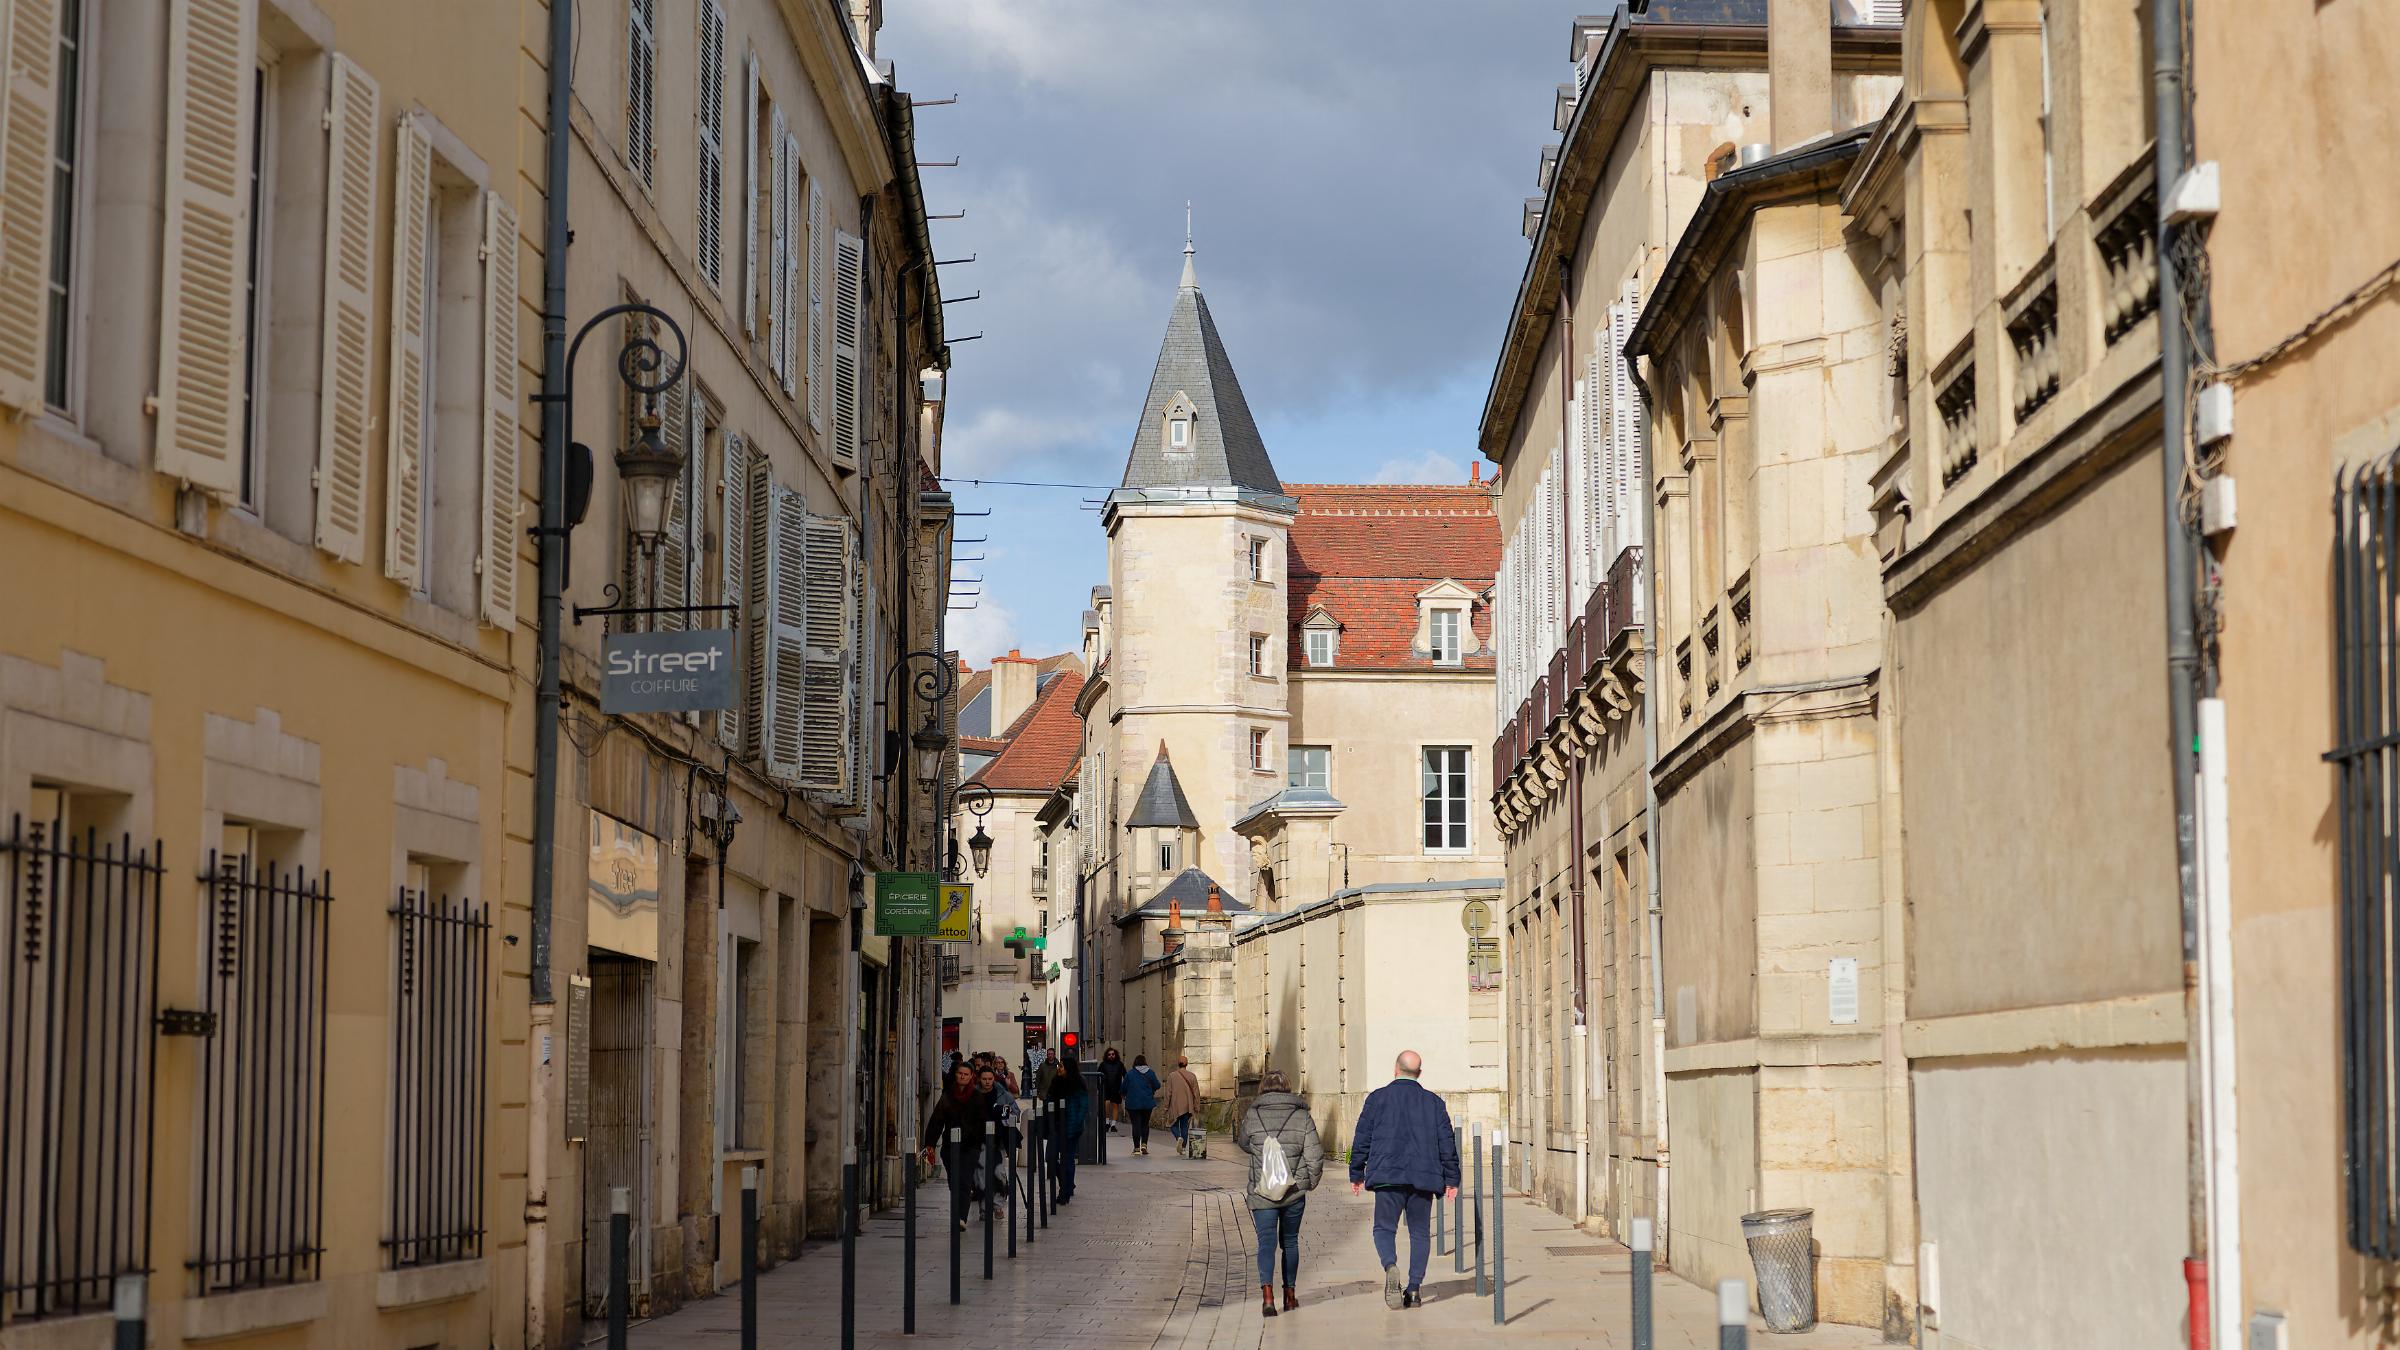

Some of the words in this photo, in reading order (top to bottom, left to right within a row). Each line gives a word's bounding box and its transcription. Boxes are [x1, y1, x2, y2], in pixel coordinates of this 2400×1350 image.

[608, 646, 722, 675] Street
[631, 678, 698, 694] COIFFURE
[888, 893, 927, 901] ÉPICERIE
[940, 928, 966, 937] attoo
